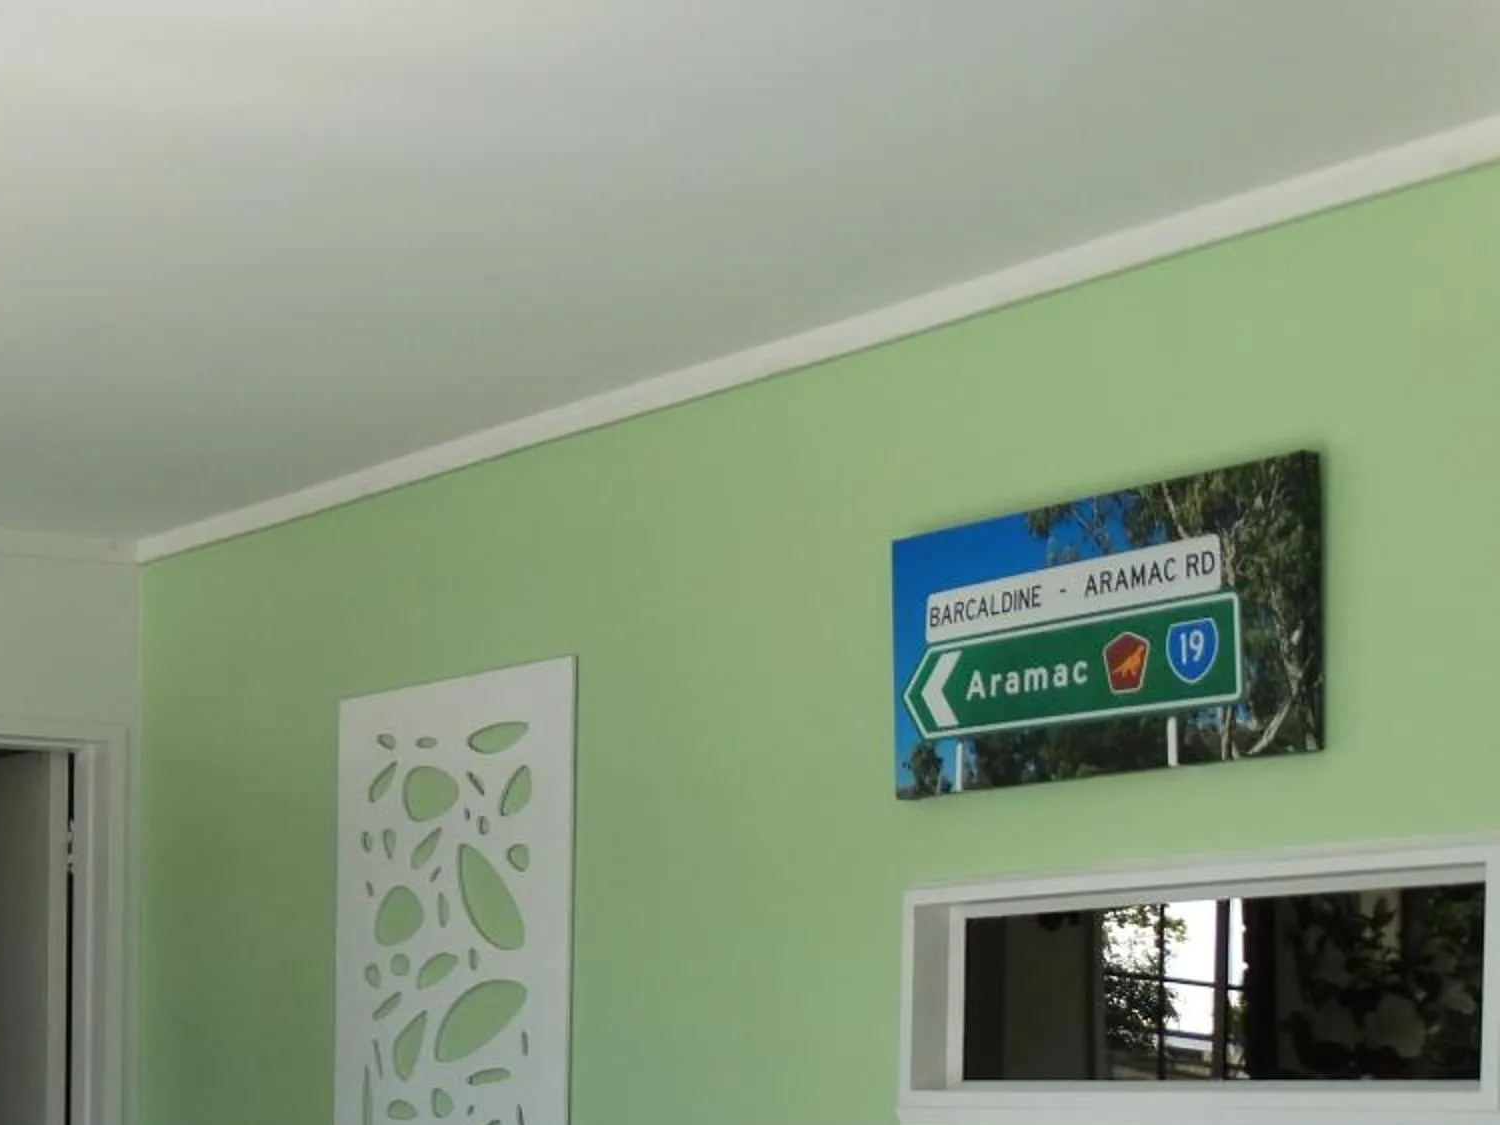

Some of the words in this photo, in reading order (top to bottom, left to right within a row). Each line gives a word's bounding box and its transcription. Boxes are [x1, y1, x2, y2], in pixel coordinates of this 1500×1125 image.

[929, 584, 1043, 628] BARCALDINE
[1084, 557, 1177, 599] ARAMAC
[1185, 550, 1216, 580] RD
[1178, 629, 1206, 667] 19
[965, 659, 1089, 702] Aramac
